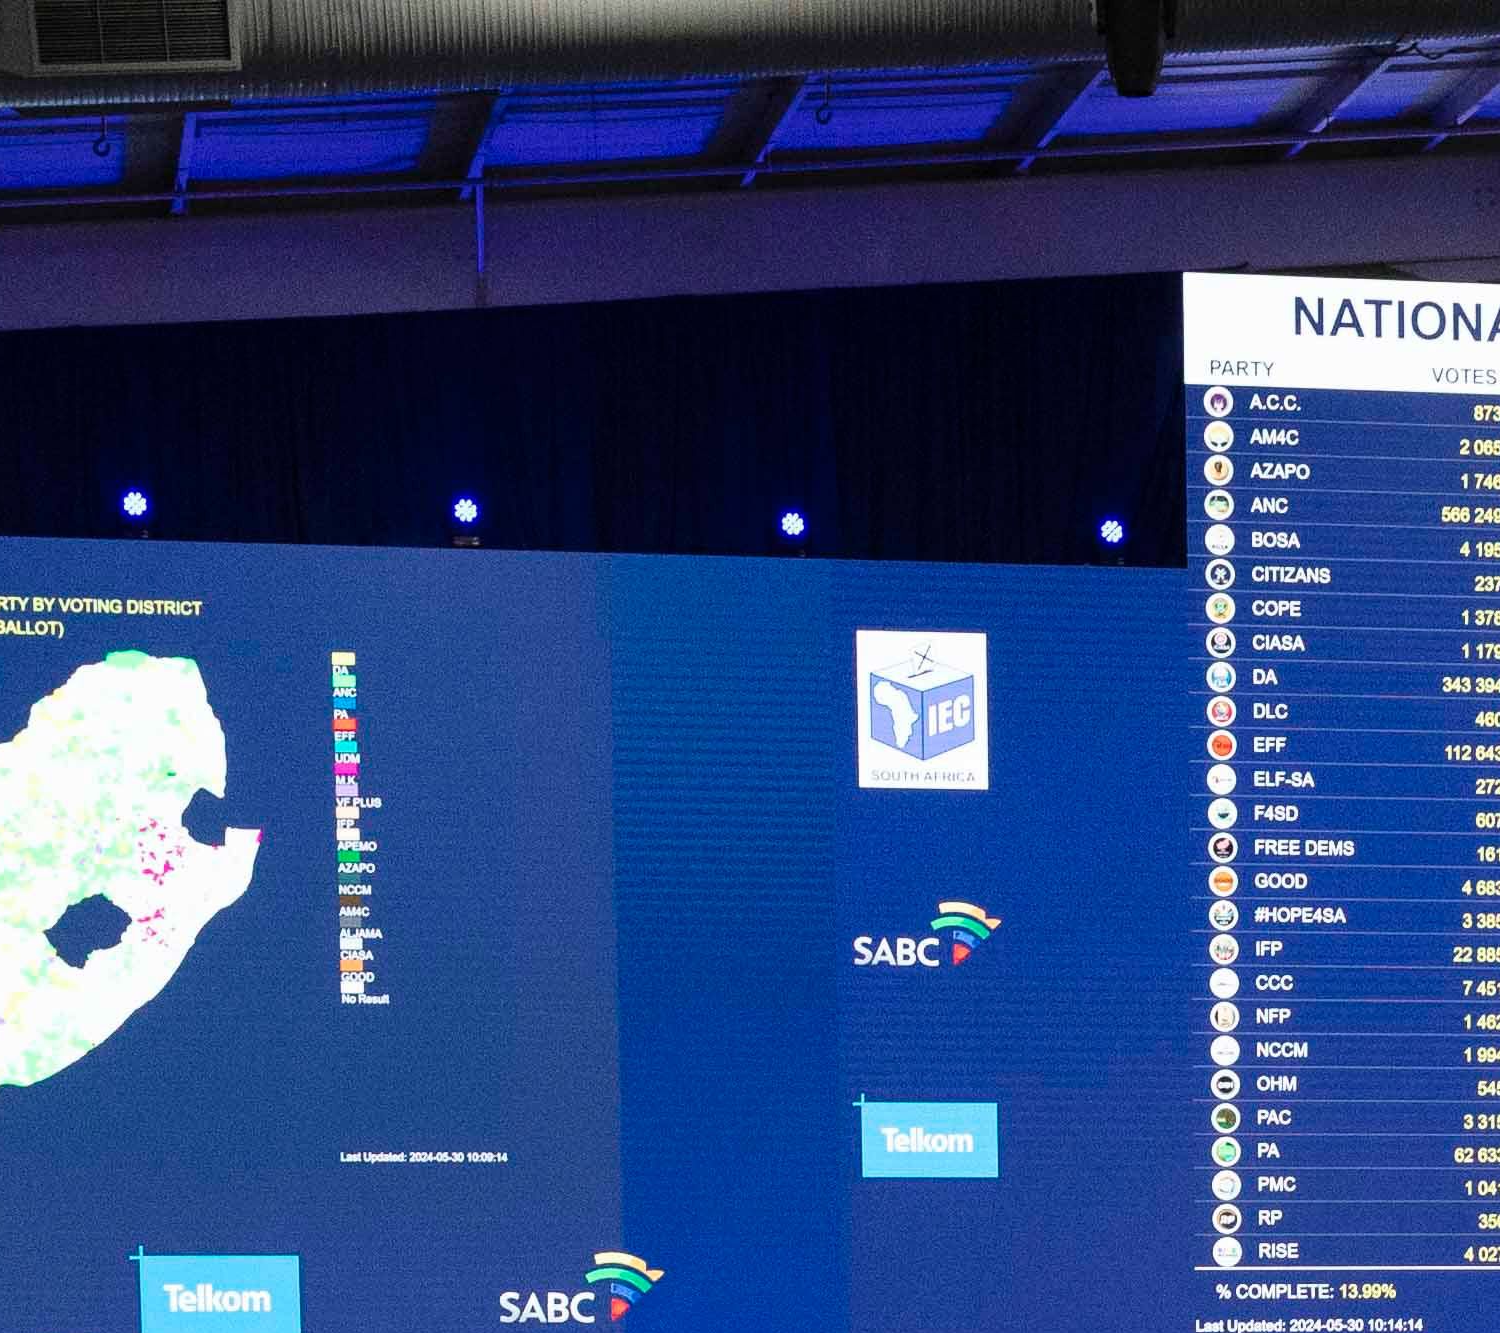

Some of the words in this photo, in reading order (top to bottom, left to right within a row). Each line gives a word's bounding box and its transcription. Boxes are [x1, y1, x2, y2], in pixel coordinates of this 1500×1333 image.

[1211, 360, 1273, 376] PARTY
[1432, 368, 1496, 384] VOTES
[1250, 394, 1301, 410] A.C.C.
[1251, 429, 1298, 445] AM4C
[1251, 463, 1310, 479] AZAPO
[1251, 497, 1288, 513] ANC
[1252, 532, 1300, 548] BOSA
[1252, 567, 1330, 583] CITIZANS
[33, 597, 55, 611] BY
[59, 598, 122, 613] VOTING
[127, 600, 202, 615] DISTRICT
[1253, 635, 1305, 651] CIASA
[928, 695, 970, 736] IEC
[1254, 703, 1288, 719] DLC
[1254, 737, 1286, 752] EFF
[335, 753, 361, 764] UDM
[871, 771, 920, 781] SOUTH
[924, 772, 975, 782] AFRICA
[1254, 771, 1314, 787] ELF-SA
[1255, 805, 1298, 821] F4SD
[337, 840, 378, 852] APEMO
[1255, 839, 1300, 855] FREE
[1306, 840, 1354, 856] DEMS
[338, 863, 375, 874] AZAPO
[1255, 873, 1307, 889] GOOD
[338, 884, 372, 896] NCCM
[338, 906, 370, 917] AM4C
[1255, 907, 1346, 923] #HOPE4SA
[339, 928, 383, 939] ALJAMA
[340, 950, 374, 961] CIASA
[854, 937, 939, 966] SABC
[341, 971, 375, 983] GOOD
[1256, 975, 1293, 990] CCC
[1257, 1008, 1291, 1023] NFP
[1257, 1042, 1307, 1057] NCCM
[1257, 1076, 1296, 1091] OHM
[1258, 1110, 1291, 1125] PAC
[881, 1127, 973, 1152] Telkom
[341, 1152, 361, 1161] Last
[363, 1152, 407, 1163] Updated:
[1259, 1176, 1296, 1191] PMC
[1259, 1210, 1282, 1225] RP
[1259, 1243, 1299, 1258] RISE
[164, 1284, 271, 1312] Telkom
[1216, 1284, 1231, 1299] %
[1236, 1284, 1334, 1299] COMPLETE:
[1340, 1284, 1396, 1299] 13.99%
[500, 1292, 595, 1323] SABC
[1196, 1320, 1224, 1332] Last
[1290, 1319, 1364, 1332] 2024-05-30
[1368, 1319, 1423, 1331] 10:14:14
